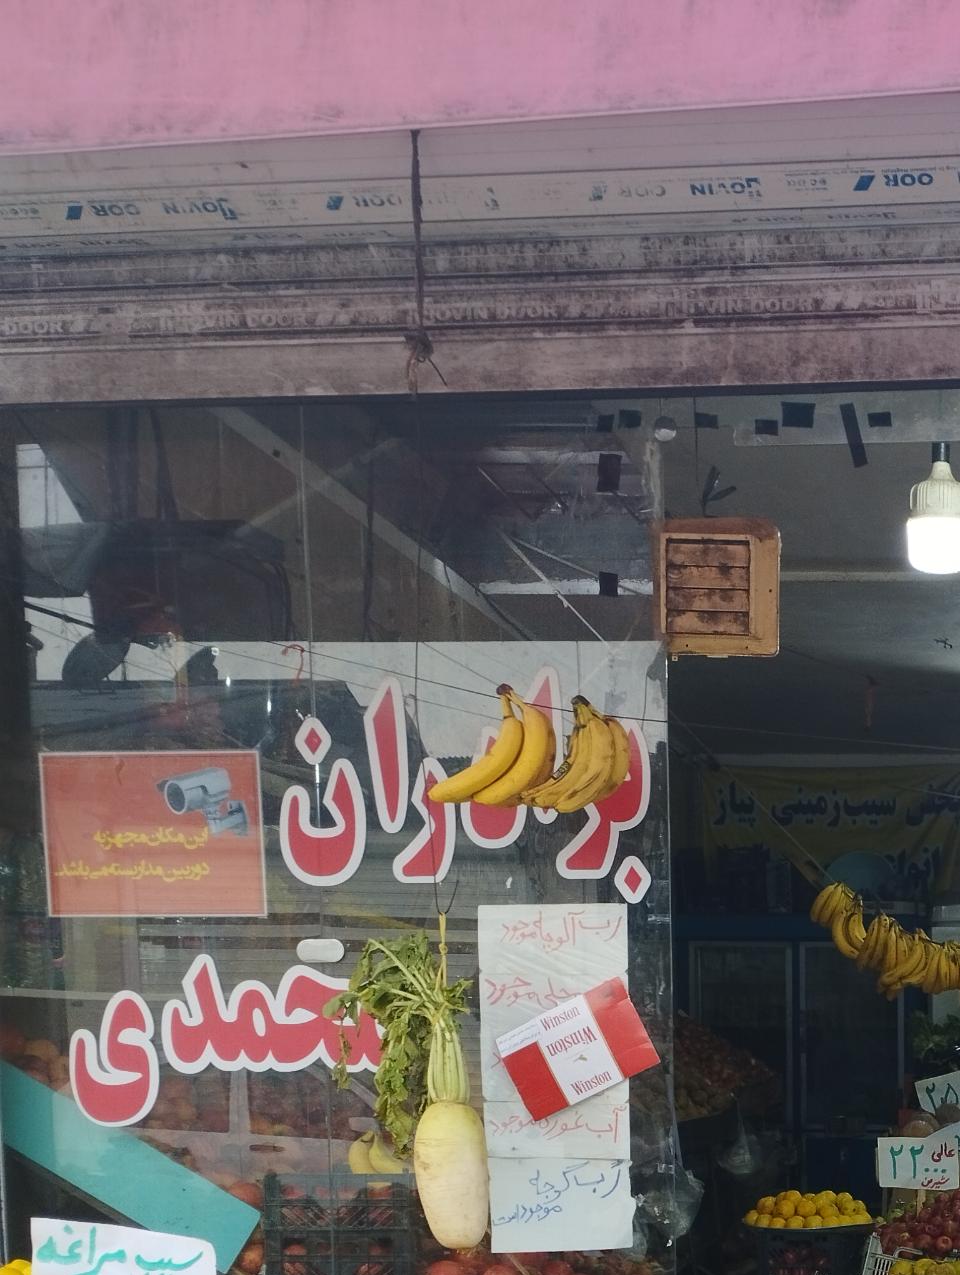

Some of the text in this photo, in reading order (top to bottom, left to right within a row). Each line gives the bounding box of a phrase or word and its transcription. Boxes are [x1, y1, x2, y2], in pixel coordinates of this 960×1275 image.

[883, 171, 934, 188] OOR
[540, 1005, 581, 1032] Winston
[546, 1025, 598, 1058] Winston
[570, 1071, 612, 1096] Winston
